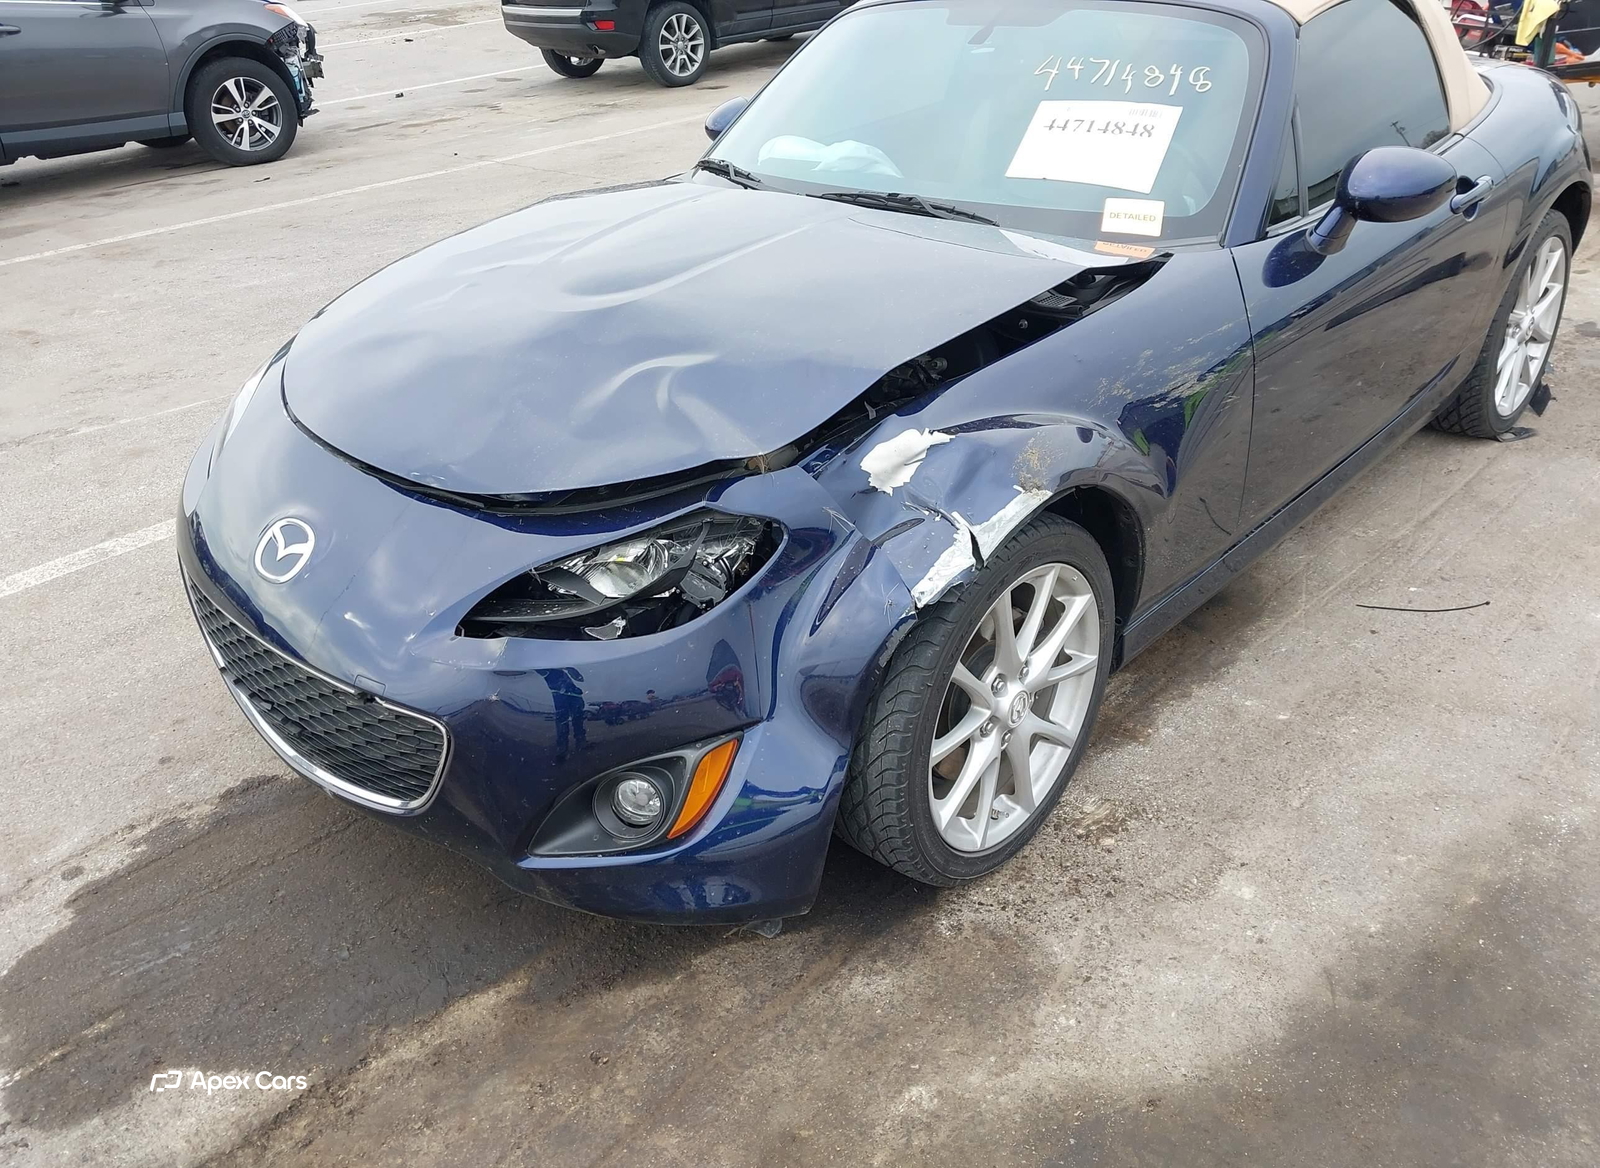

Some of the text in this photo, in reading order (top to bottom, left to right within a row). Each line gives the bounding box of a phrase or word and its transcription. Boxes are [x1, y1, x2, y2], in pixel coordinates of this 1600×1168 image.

[1033, 55, 1213, 96] 44714848
[1043, 118, 1155, 138] 44714848
[1109, 211, 1156, 222] DETAILED
